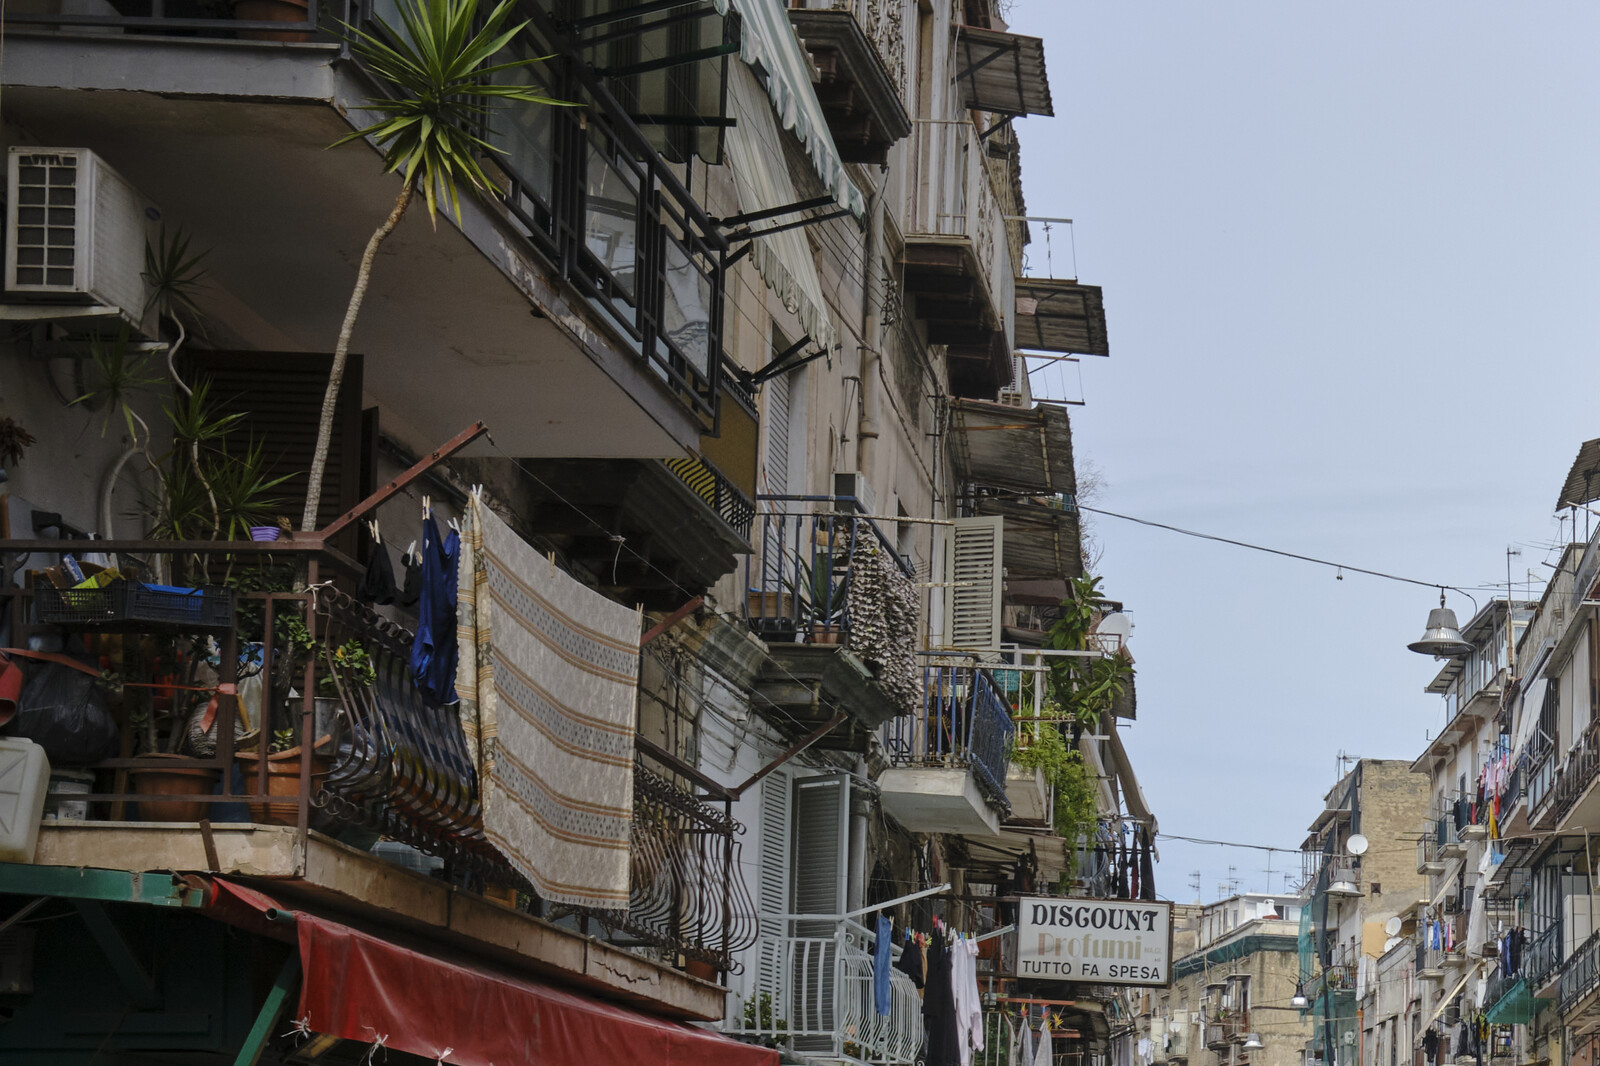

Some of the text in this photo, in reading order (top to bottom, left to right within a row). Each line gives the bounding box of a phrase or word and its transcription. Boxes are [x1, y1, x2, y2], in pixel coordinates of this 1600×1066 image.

[1031, 904, 1158, 931] DISCOUNT
[1037, 932, 1143, 960] Profumi
[1022, 960, 1160, 979] TUTTO FA SPESA
